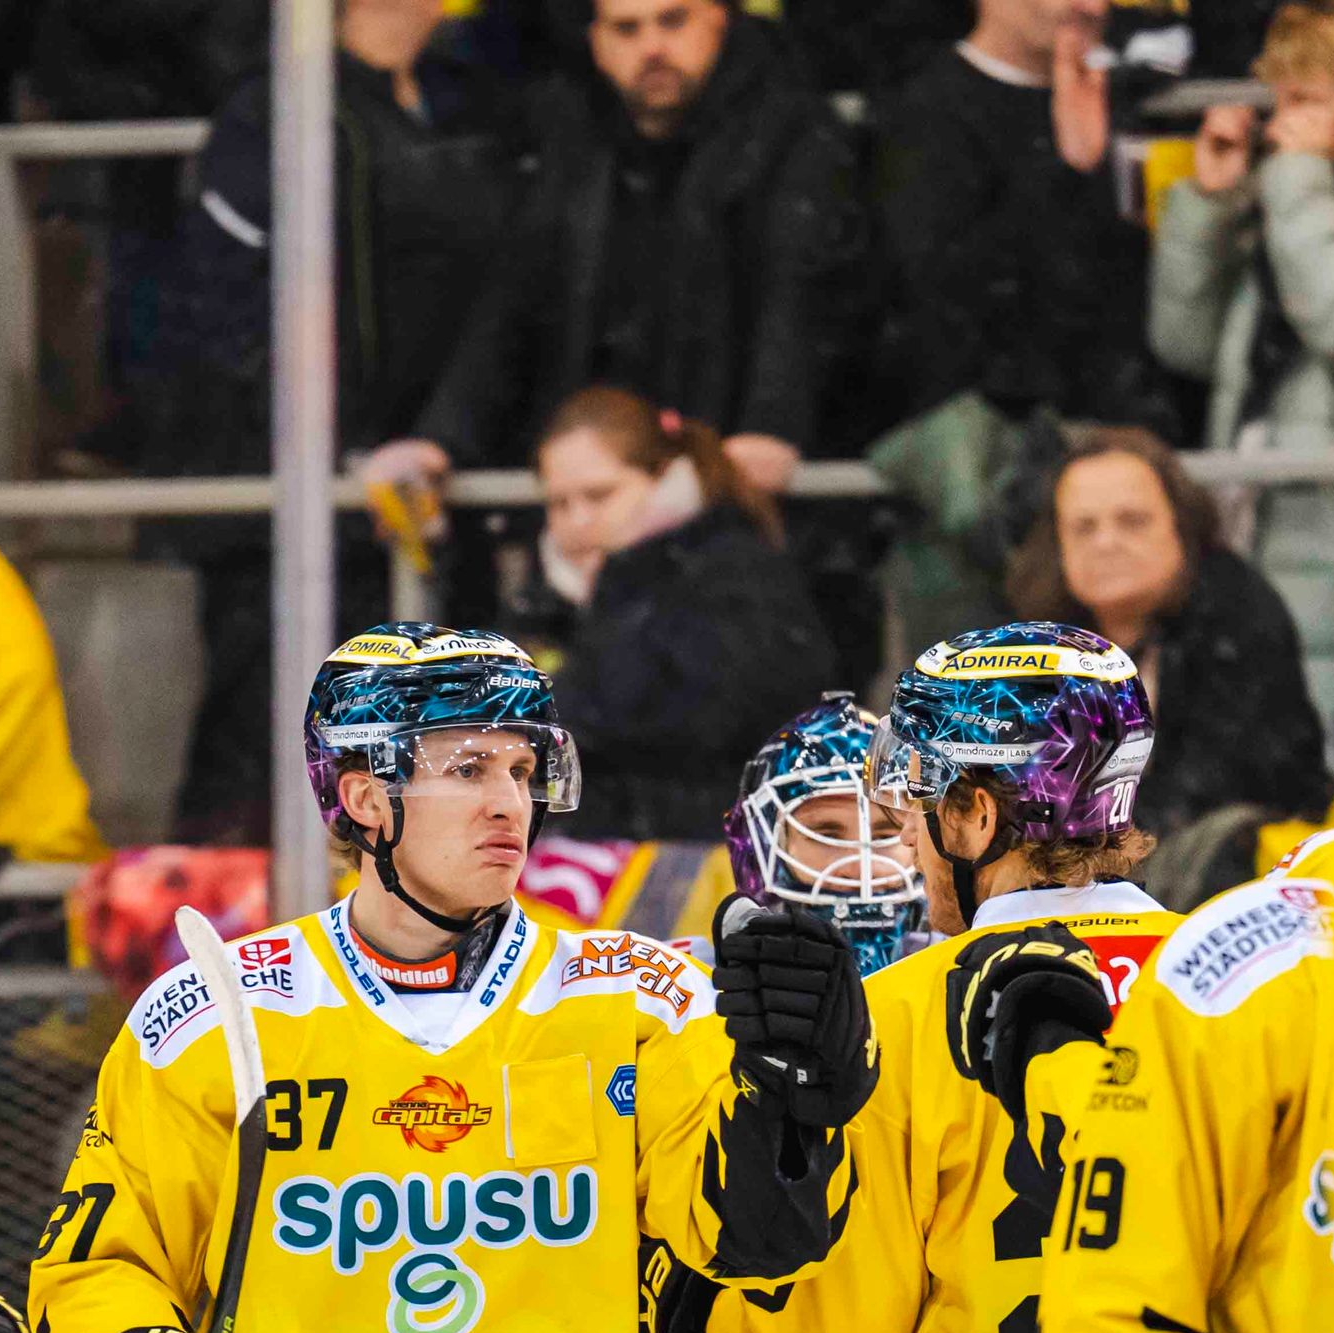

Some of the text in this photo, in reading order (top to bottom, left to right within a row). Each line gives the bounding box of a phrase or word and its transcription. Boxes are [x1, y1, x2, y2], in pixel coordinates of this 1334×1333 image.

[339, 640, 414, 661] ADMIRAL
[942, 653, 1055, 673] ADMIRAL
[955, 745, 1032, 758] mindmaze LABS
[1108, 781, 1135, 825] 20
[329, 906, 386, 1008] STADLER
[267, 1078, 349, 1152] 37
[372, 1104, 492, 1133] capitals
[37, 1182, 116, 1263] 37
[277, 1172, 593, 1271] spusu
[1063, 1156, 1127, 1253] 19
